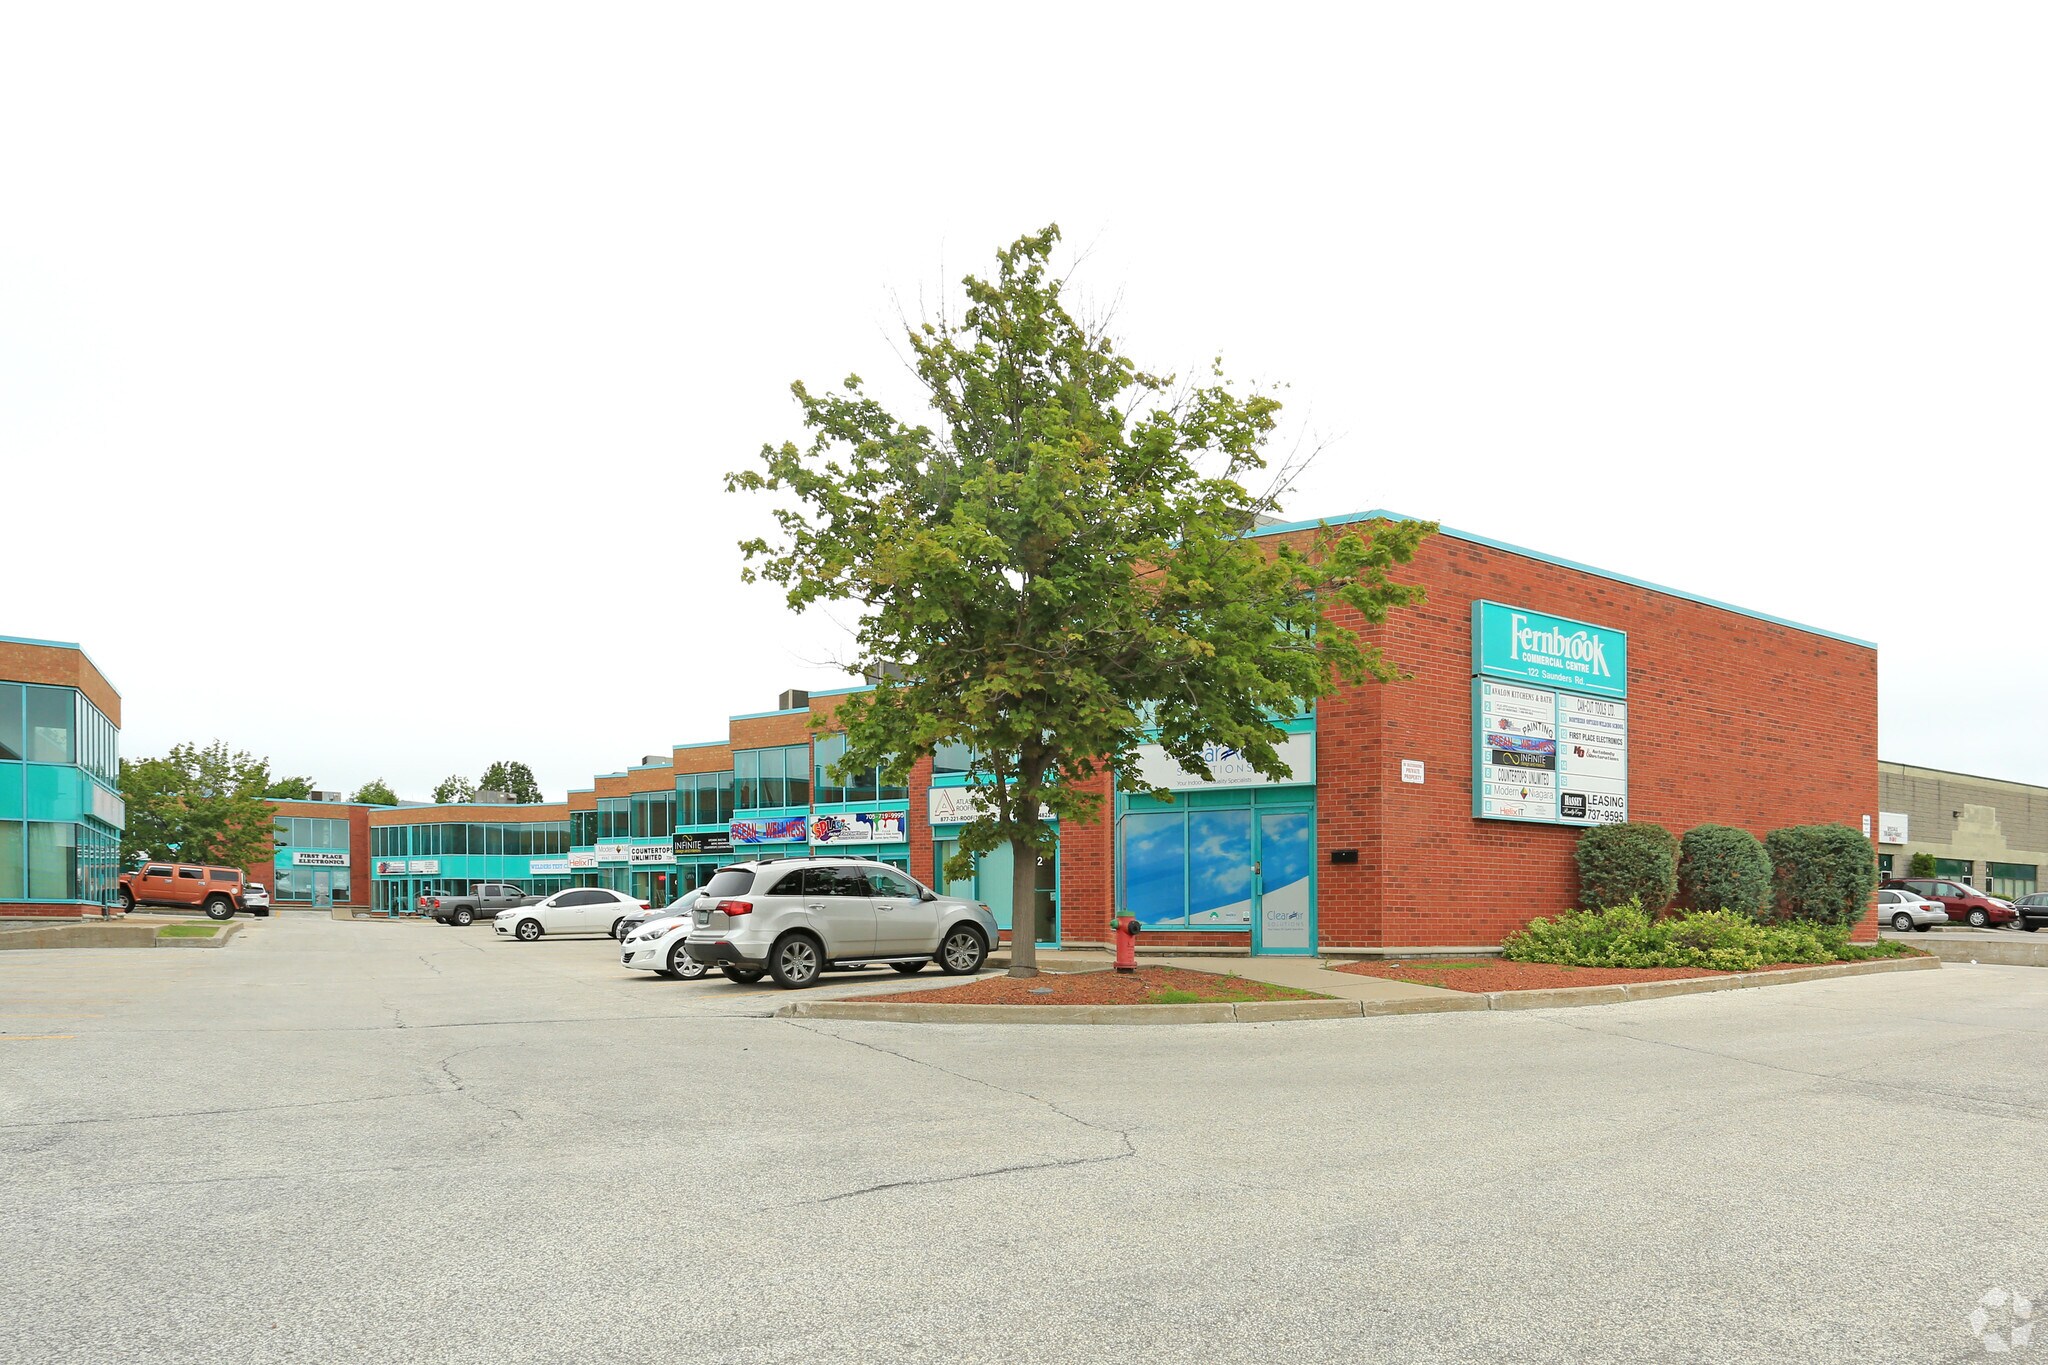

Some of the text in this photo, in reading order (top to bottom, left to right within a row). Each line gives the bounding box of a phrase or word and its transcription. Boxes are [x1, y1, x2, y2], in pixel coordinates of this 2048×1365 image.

[1510, 613, 1611, 677] Fernbrook
[1522, 651, 1590, 673] COMMERCIAL CENTRE
[1527, 667, 1585, 685] 122 Saunders Rd.
[1492, 687, 1553, 704] AVALON KITCHENS & BATH
[1576, 698, 1616, 717] CAN-CUT TOOLS LTD.
[1522, 721, 1554, 739] PAINTING
[1487, 734, 1513, 748] OCEAN
[1568, 731, 1623, 746] FIRST PLACE ELECTRONICS
[1520, 753, 1546, 765] INFINITE
[1176, 763, 1253, 777] STIONS
[1497, 768, 1550, 786] COUNTERTOPS UNLIMITED
[1494, 785, 1554, 801] Modern Niagara
[1587, 794, 1624, 808] LEASING
[865, 811, 905, 820] 705-719-9995
[1587, 809, 1624, 823] 737-9595
[731, 820, 806, 841] OCEAN WELLNESS
[812, 819, 846, 839] SPLASH
[674, 841, 702, 850] INFINITE
[631, 854, 663, 862] UNLIMITED
[892, 861, 897, 869] 3
[1037, 856, 1043, 866] 2
